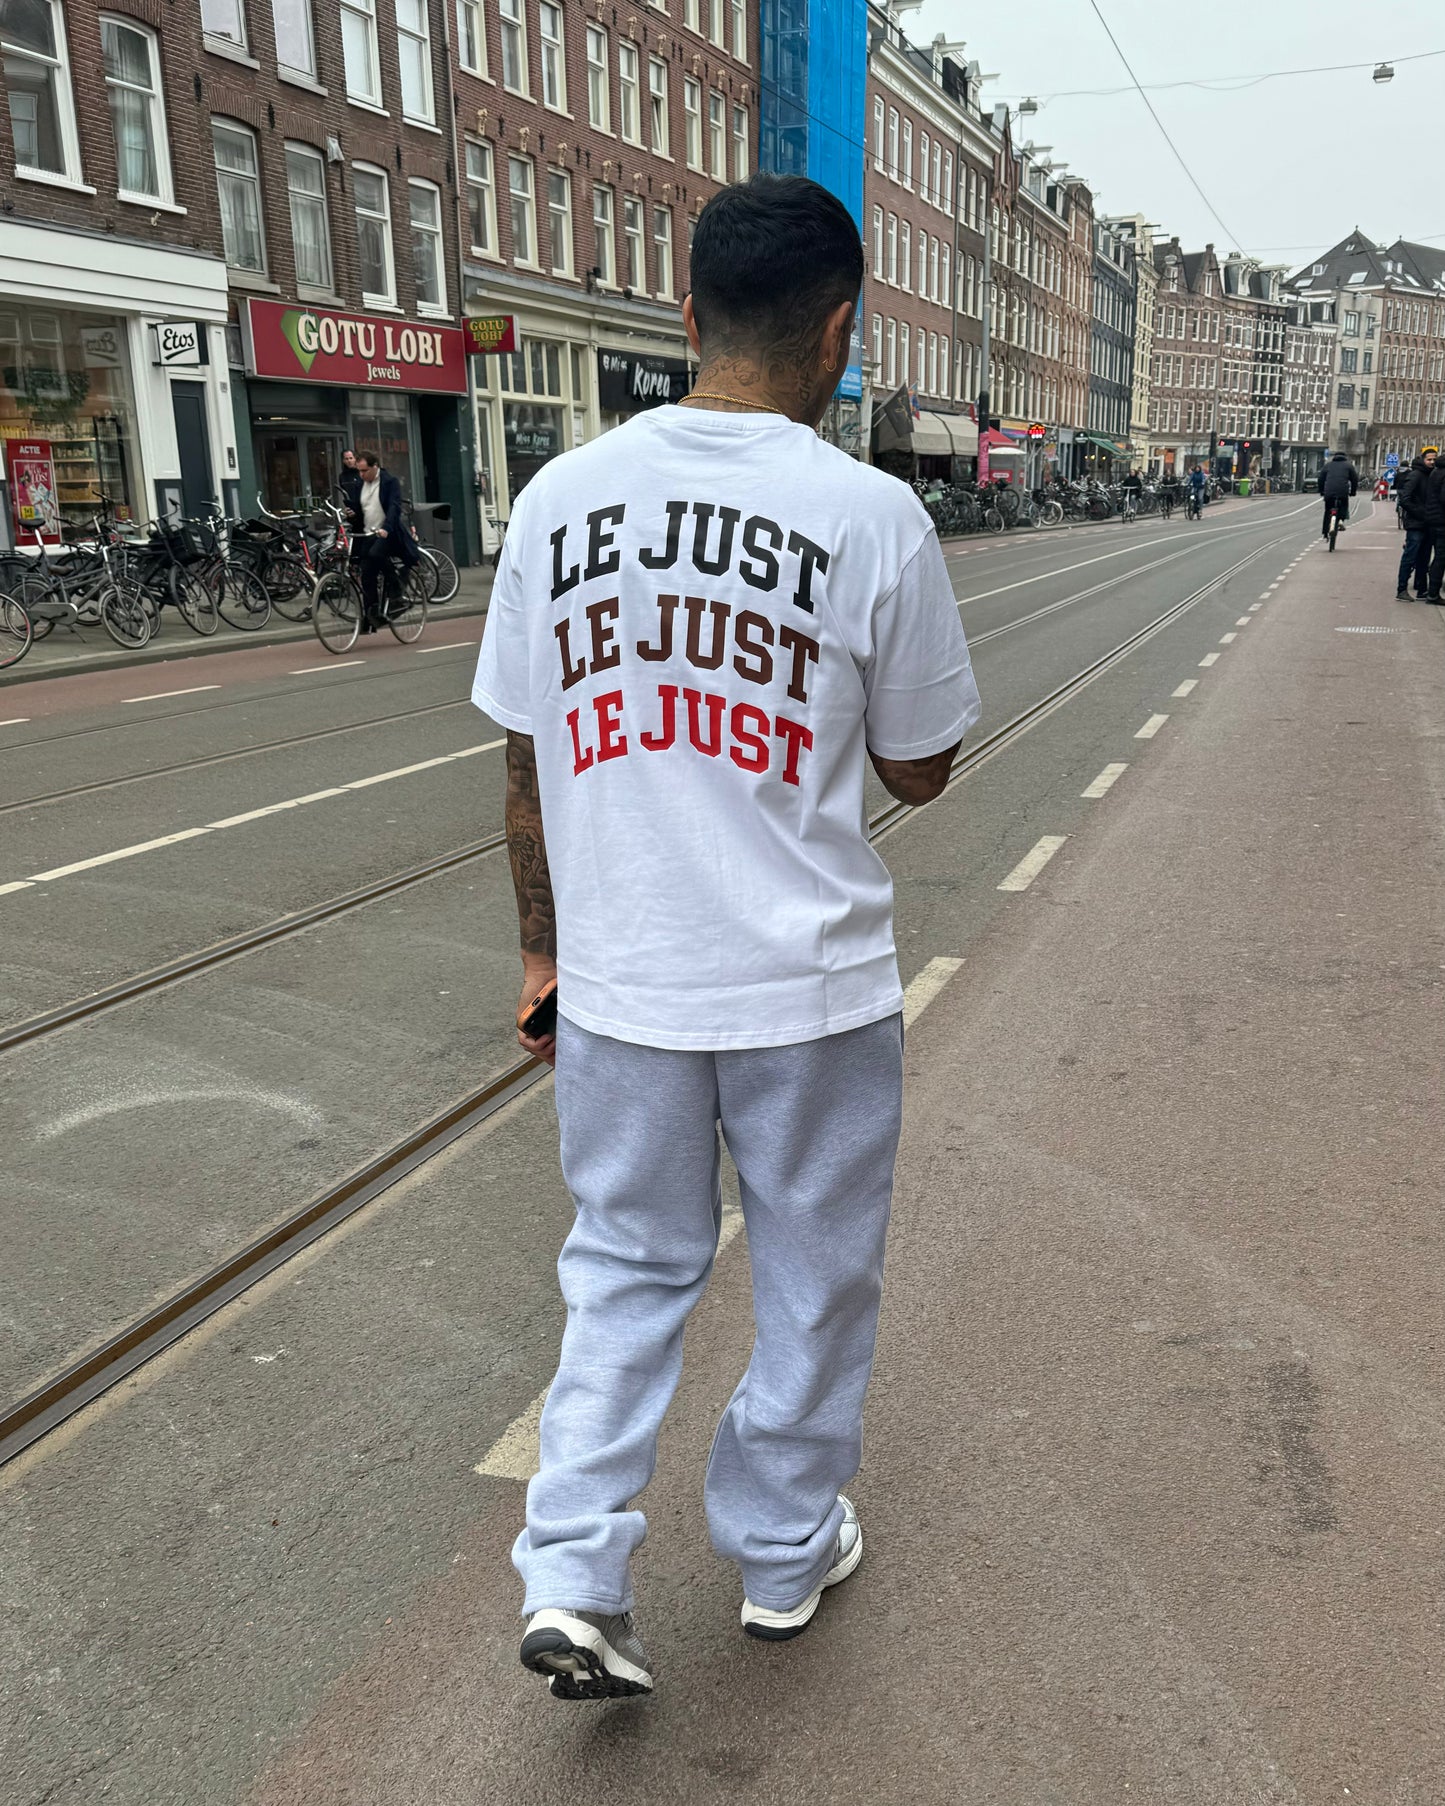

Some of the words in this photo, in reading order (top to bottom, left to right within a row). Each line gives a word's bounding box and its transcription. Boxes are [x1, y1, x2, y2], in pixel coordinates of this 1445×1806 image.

[163, 328, 195, 351] Etos
[298, 313, 376, 359] GOTU
[384, 326, 444, 366] LOBI
[470, 320, 504, 331] GOTU
[473, 331, 502, 342] LOBI
[367, 363, 401, 381] Jewels
[633, 362, 671, 401] Korea
[19, 445, 41, 454] ACTIE
[550, 503, 626, 602] LE
[638, 501, 830, 615] JUST
[554, 596, 621, 691] LE
[637, 594, 820, 704] JUST
[566, 689, 628, 777] LE
[640, 685, 813, 786] JUST
